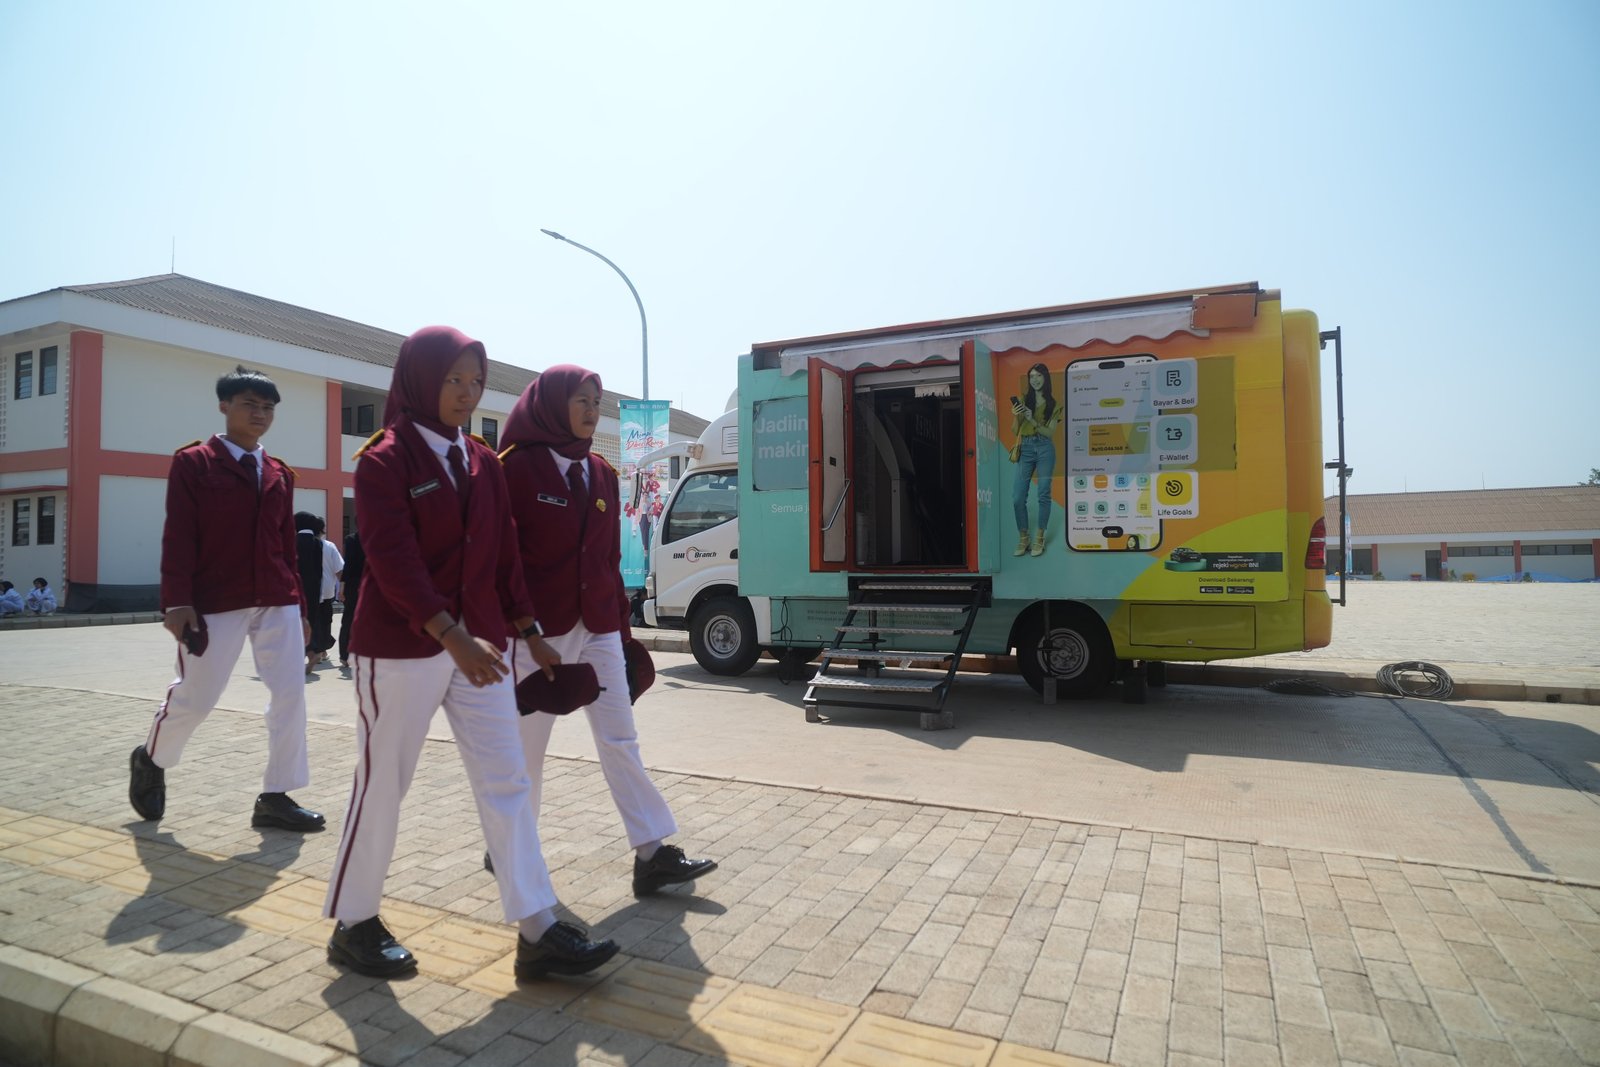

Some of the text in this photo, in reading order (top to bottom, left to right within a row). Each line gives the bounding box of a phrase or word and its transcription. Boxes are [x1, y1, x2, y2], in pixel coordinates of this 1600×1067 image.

[1153, 399, 1173, 408] Bayar
[756, 414, 808, 434] Jadiin
[1159, 453, 1189, 461] E-Wallet
[771, 504, 803, 513] Semua
[1172, 508, 1192, 516] Goals
